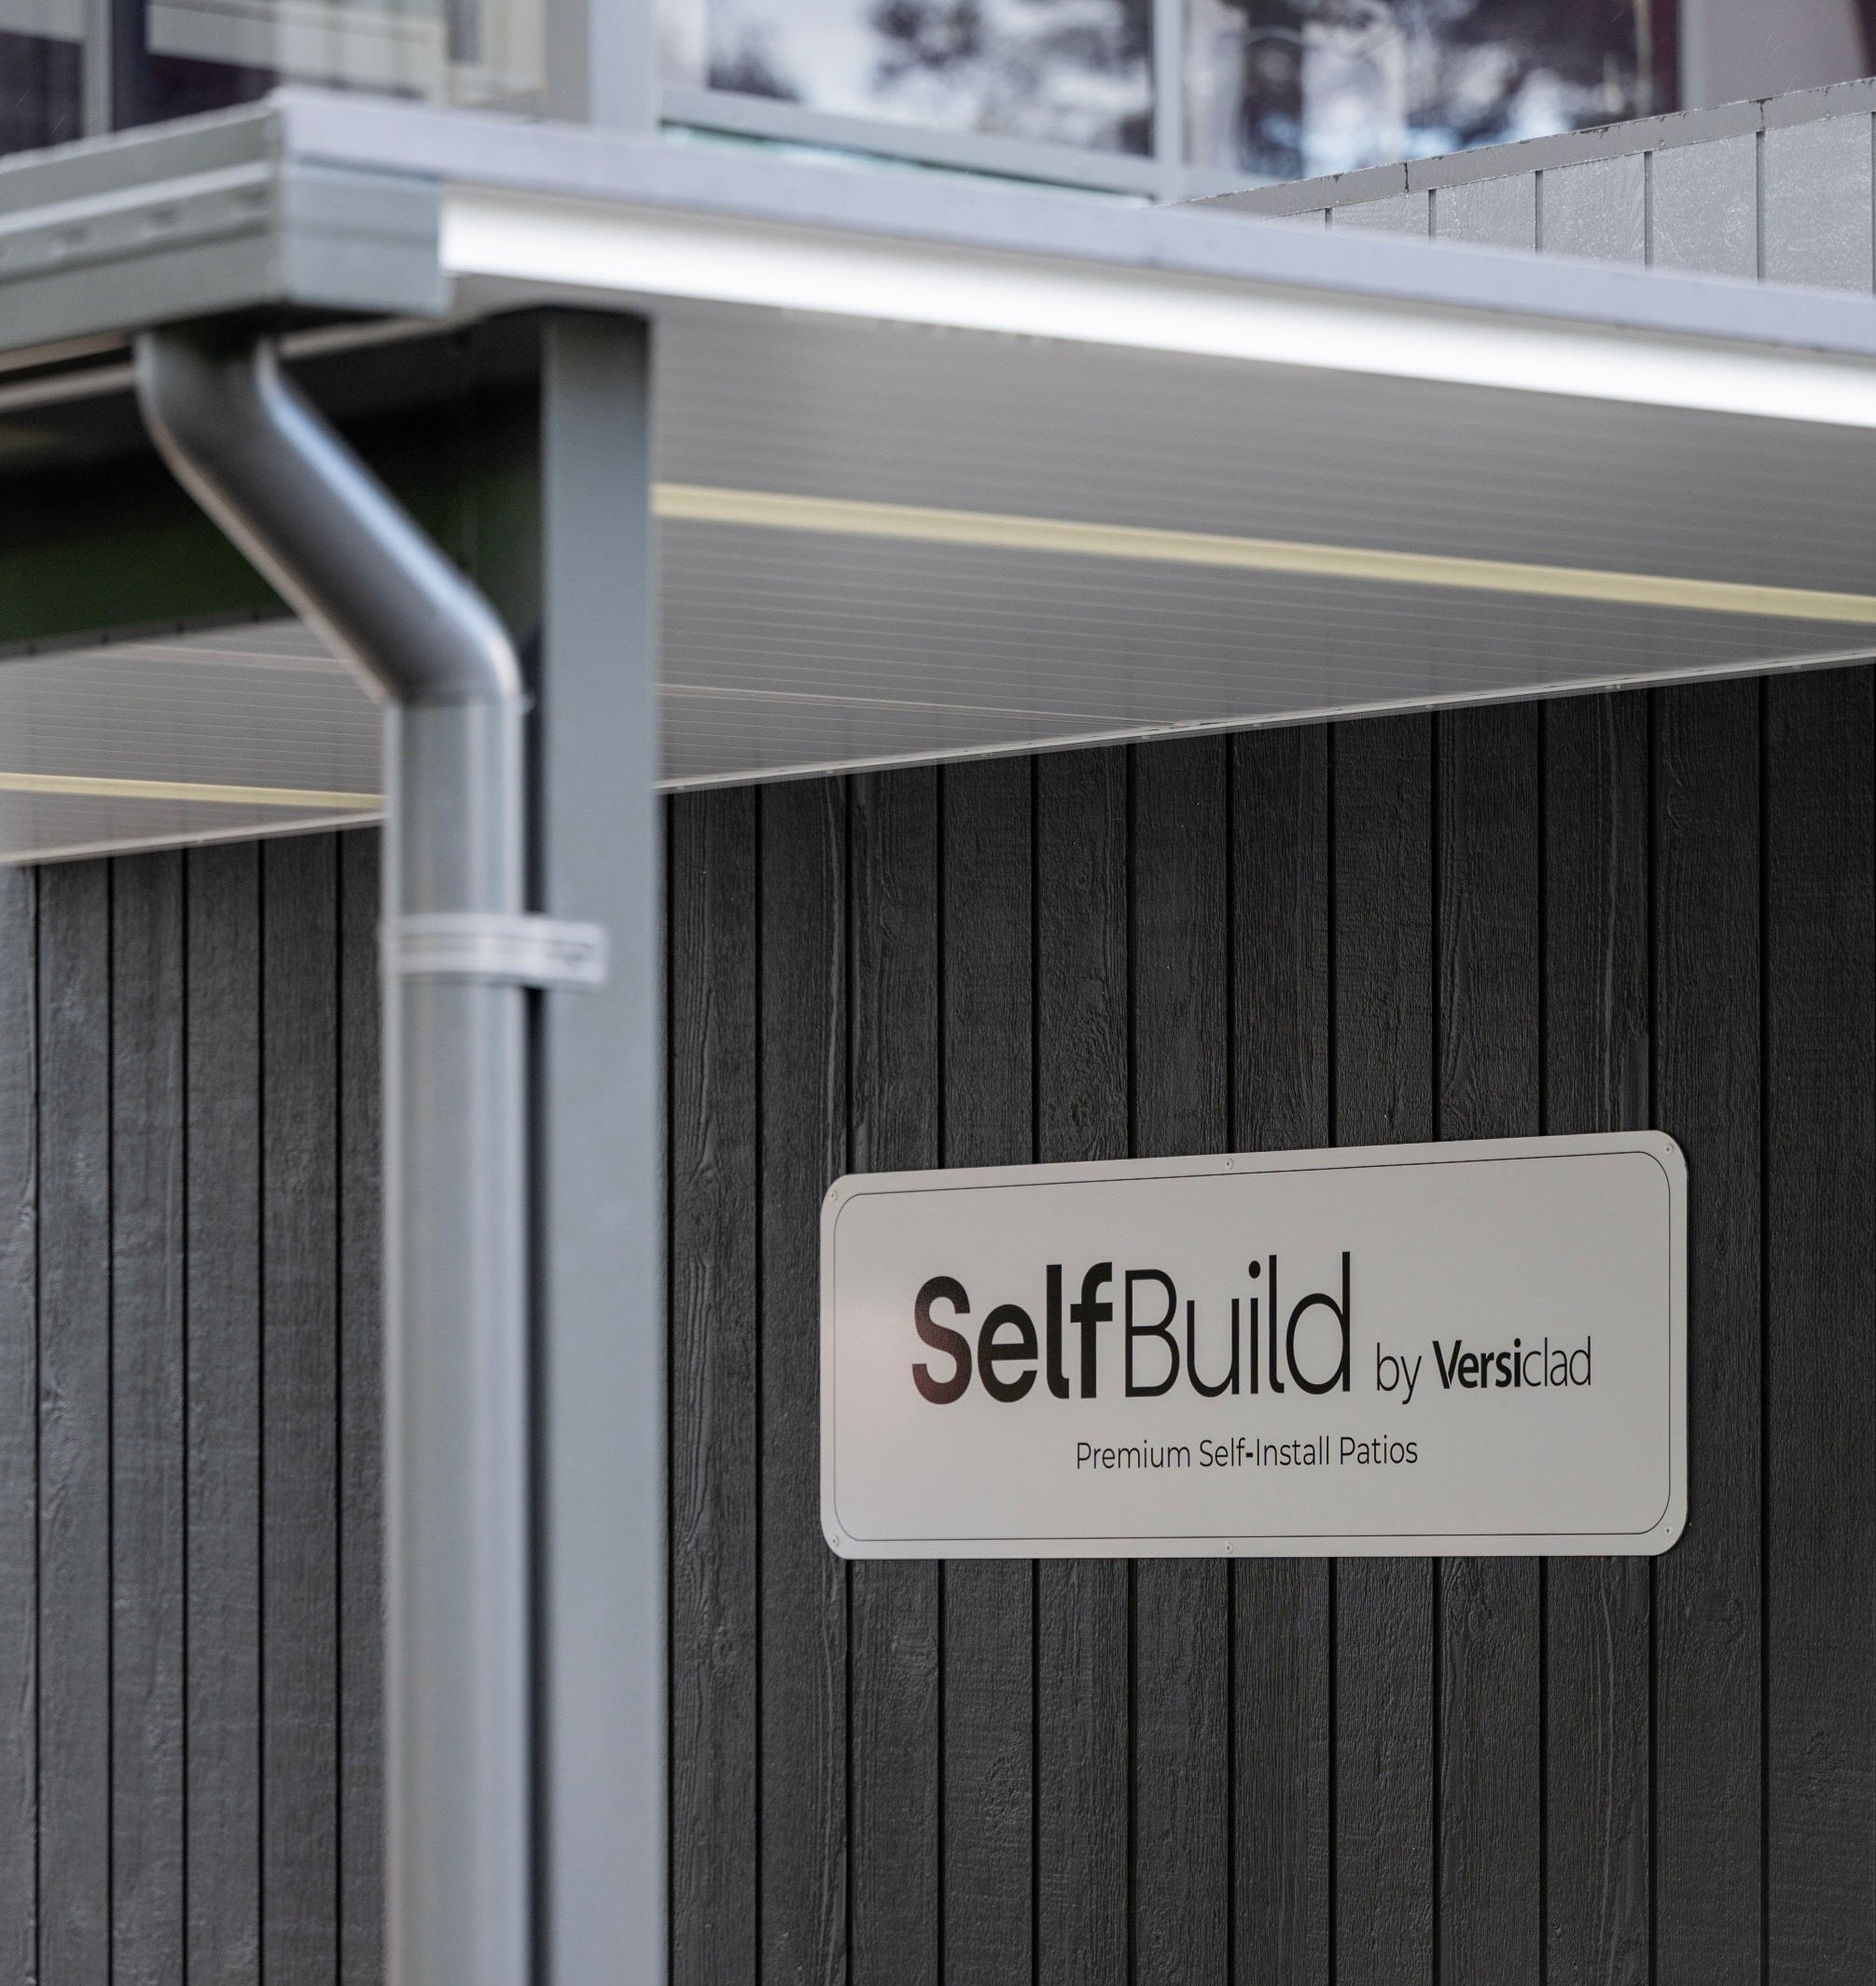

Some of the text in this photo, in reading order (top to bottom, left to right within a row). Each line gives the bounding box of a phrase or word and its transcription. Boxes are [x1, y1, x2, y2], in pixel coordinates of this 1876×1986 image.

[911, 1250, 1591, 1407] SelfBuild by Versiclad
[1077, 1434, 1418, 1470] Premium Self-Install Patios
